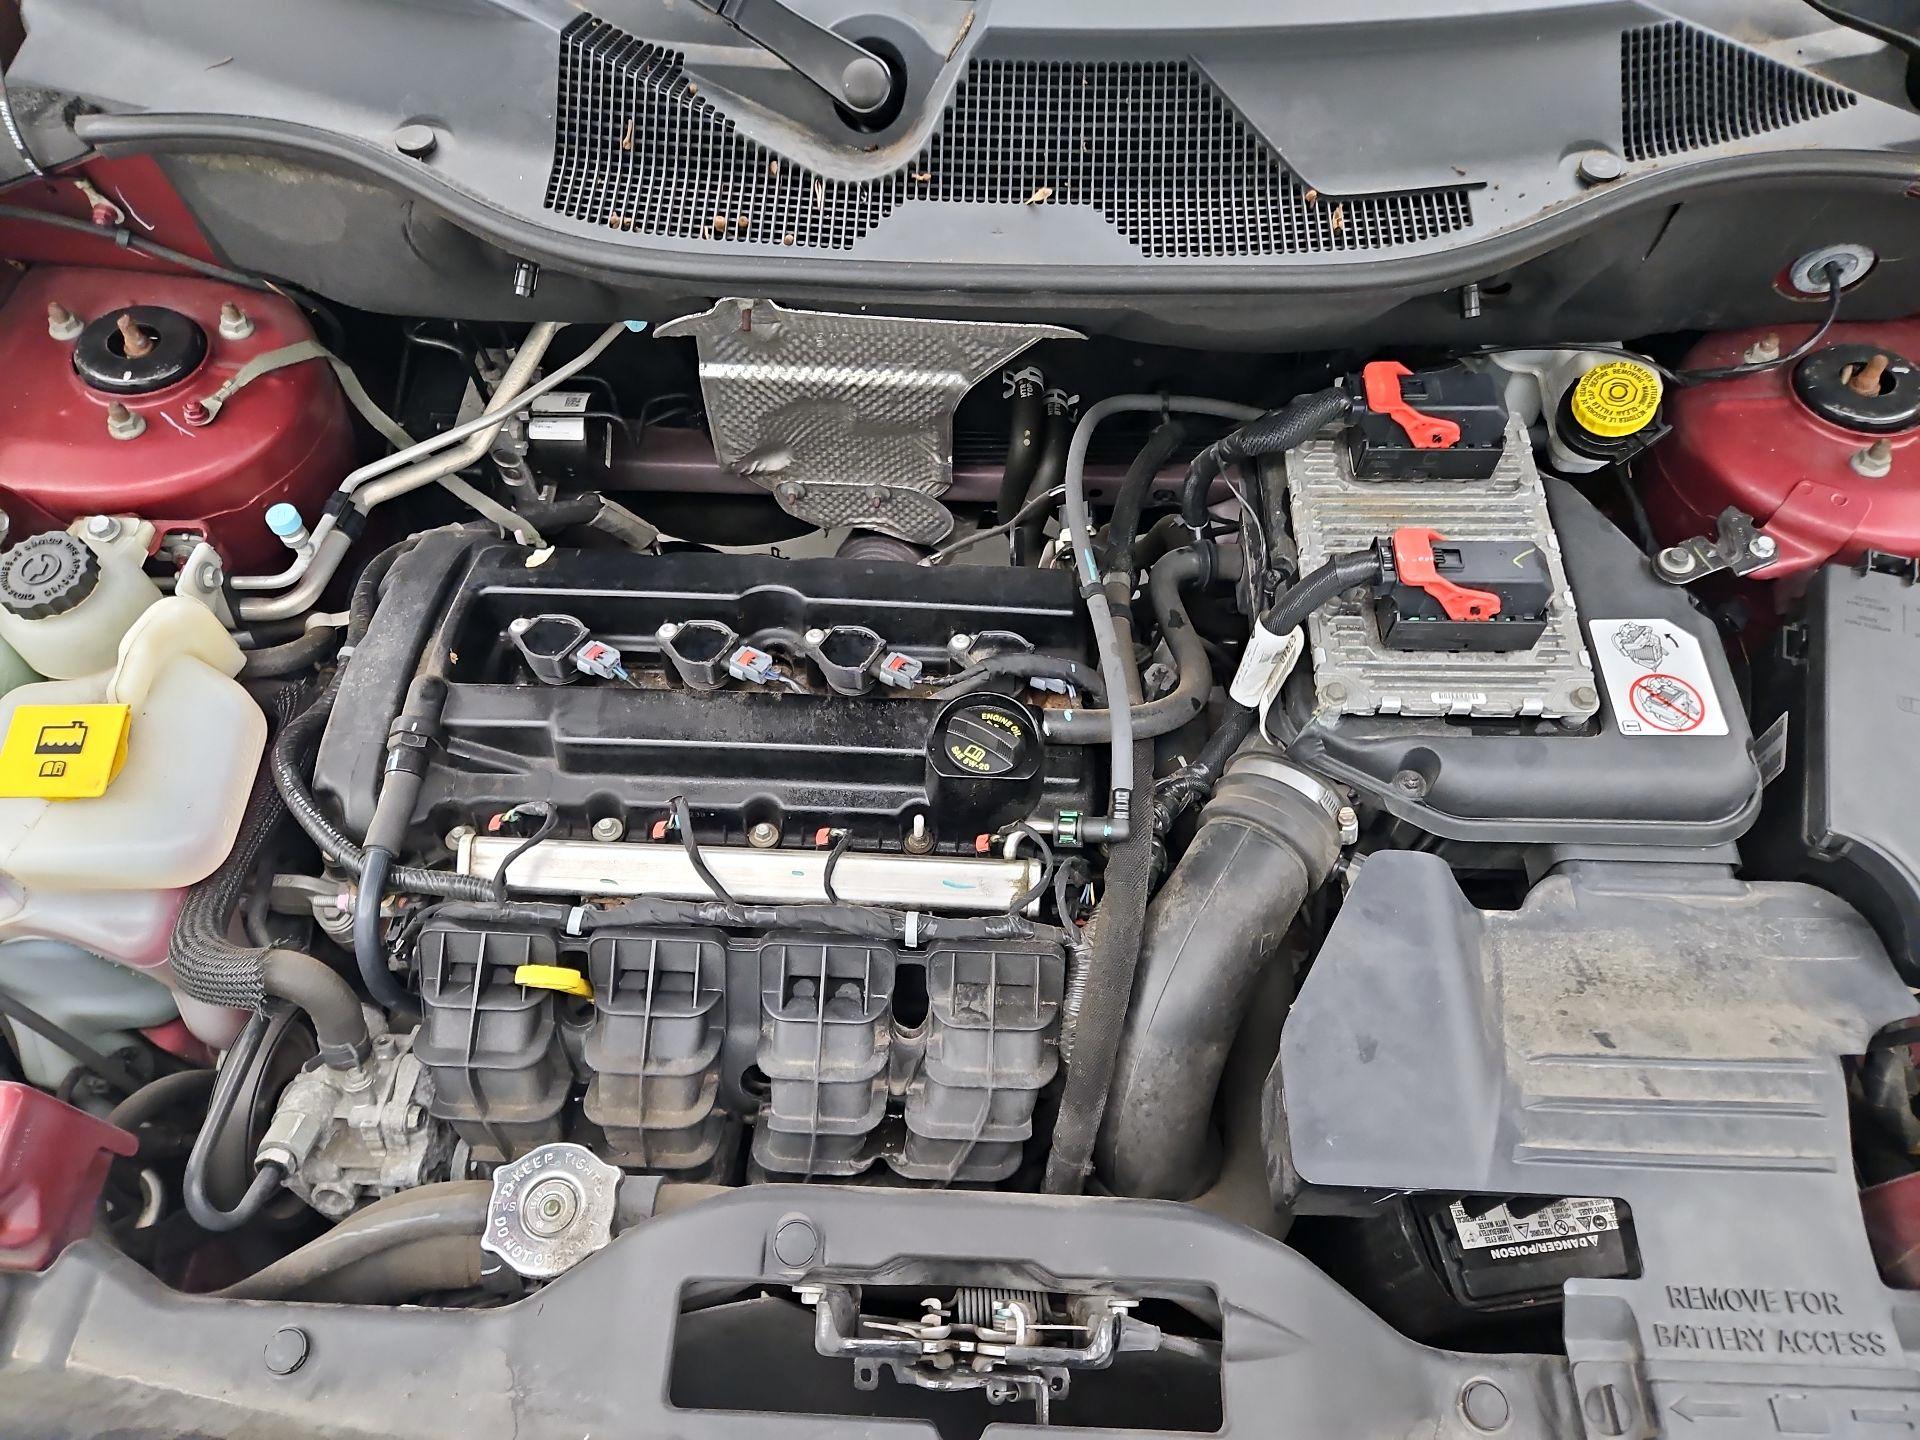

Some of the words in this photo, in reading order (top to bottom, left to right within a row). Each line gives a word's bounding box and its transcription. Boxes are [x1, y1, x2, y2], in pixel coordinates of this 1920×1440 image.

[1613, 369, 1644, 384] REMOVING
[981, 712, 1013, 727] ENGINE
[1010, 725, 1022, 738] OIL
[950, 745, 966, 761] SAE
[962, 758, 990, 771] 5W-20
[513, 1152, 554, 1182] KEEP
[1490, 1236, 1588, 1260] DANGER/POISON
[1665, 1285, 1780, 1313] REMOVE
[1783, 1289, 1845, 1315] FOR
[1653, 1321, 1765, 1353] BATTERY
[1778, 1328, 1888, 1356] ACCESS
